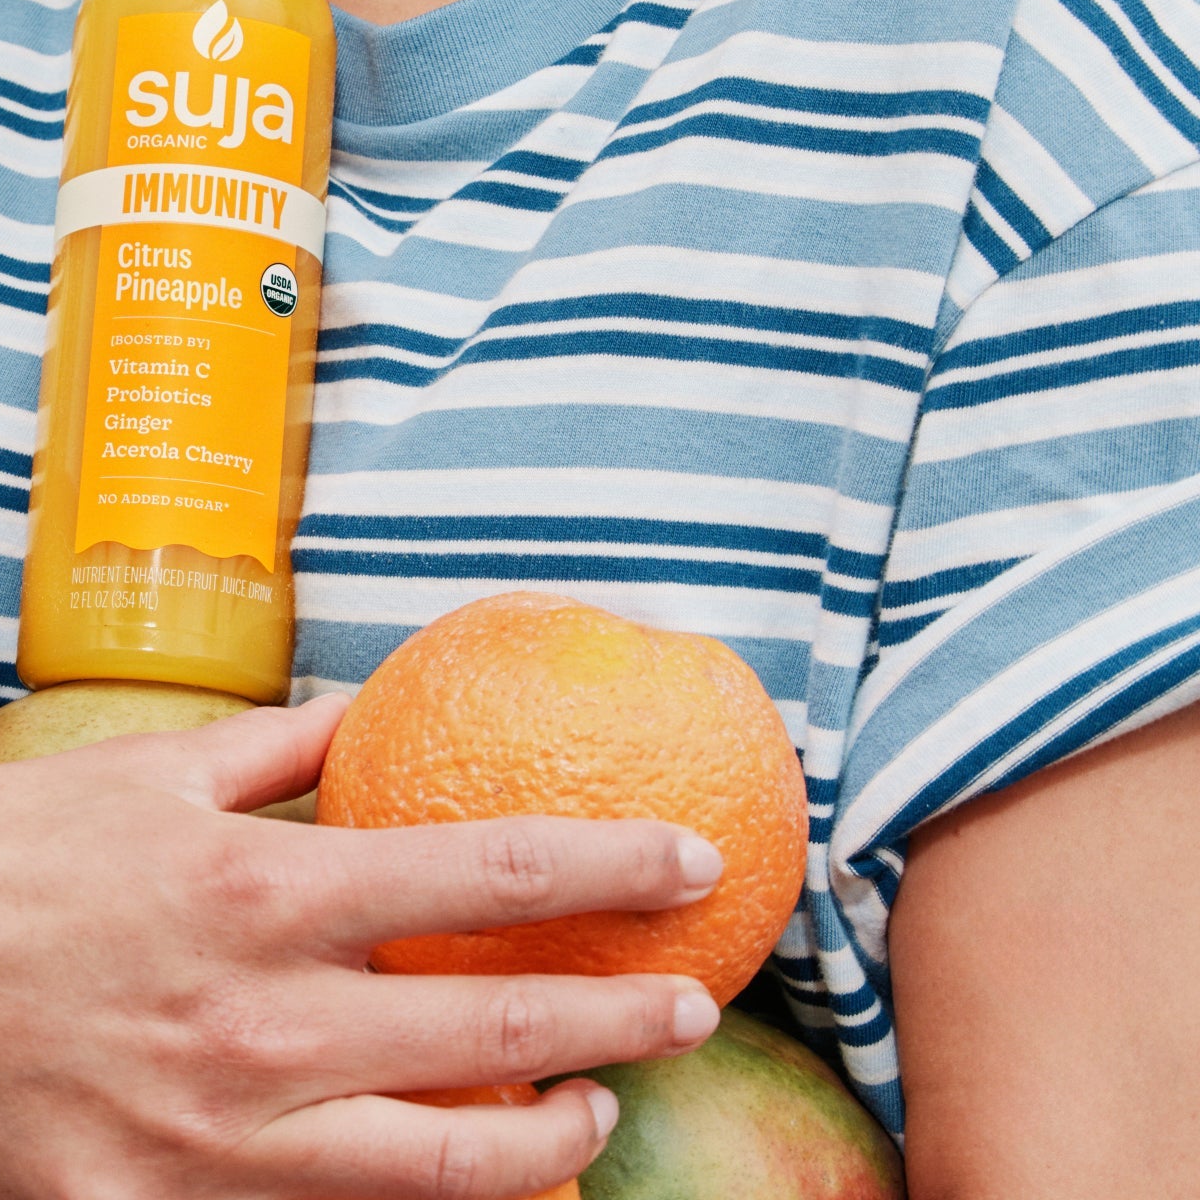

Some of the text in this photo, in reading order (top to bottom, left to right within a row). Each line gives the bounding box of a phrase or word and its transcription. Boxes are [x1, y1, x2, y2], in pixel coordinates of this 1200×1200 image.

[125, 70, 294, 149] suja
[127, 134, 208, 149] ORGANIC
[121, 172, 288, 230] IMMUNITY
[117, 242, 192, 269] Citrus
[115, 272, 243, 311] Pineapple
[271, 274, 292, 291] USDA
[266, 289, 294, 306] ORGANIC
[109, 359, 211, 379] Vitamin C
[106, 386, 212, 407] Probiotics
[104, 414, 173, 434] Ginger
[101, 441, 254, 474] Acerola Cherry
[98, 494, 118, 505] NO
[121, 494, 171, 506] ADDED
[71, 566, 273, 604] NUTRIENT ENHANCED FRUIT JUICE DRINK
[70, 591, 159, 611] 12 FL OZ (354 ML)
